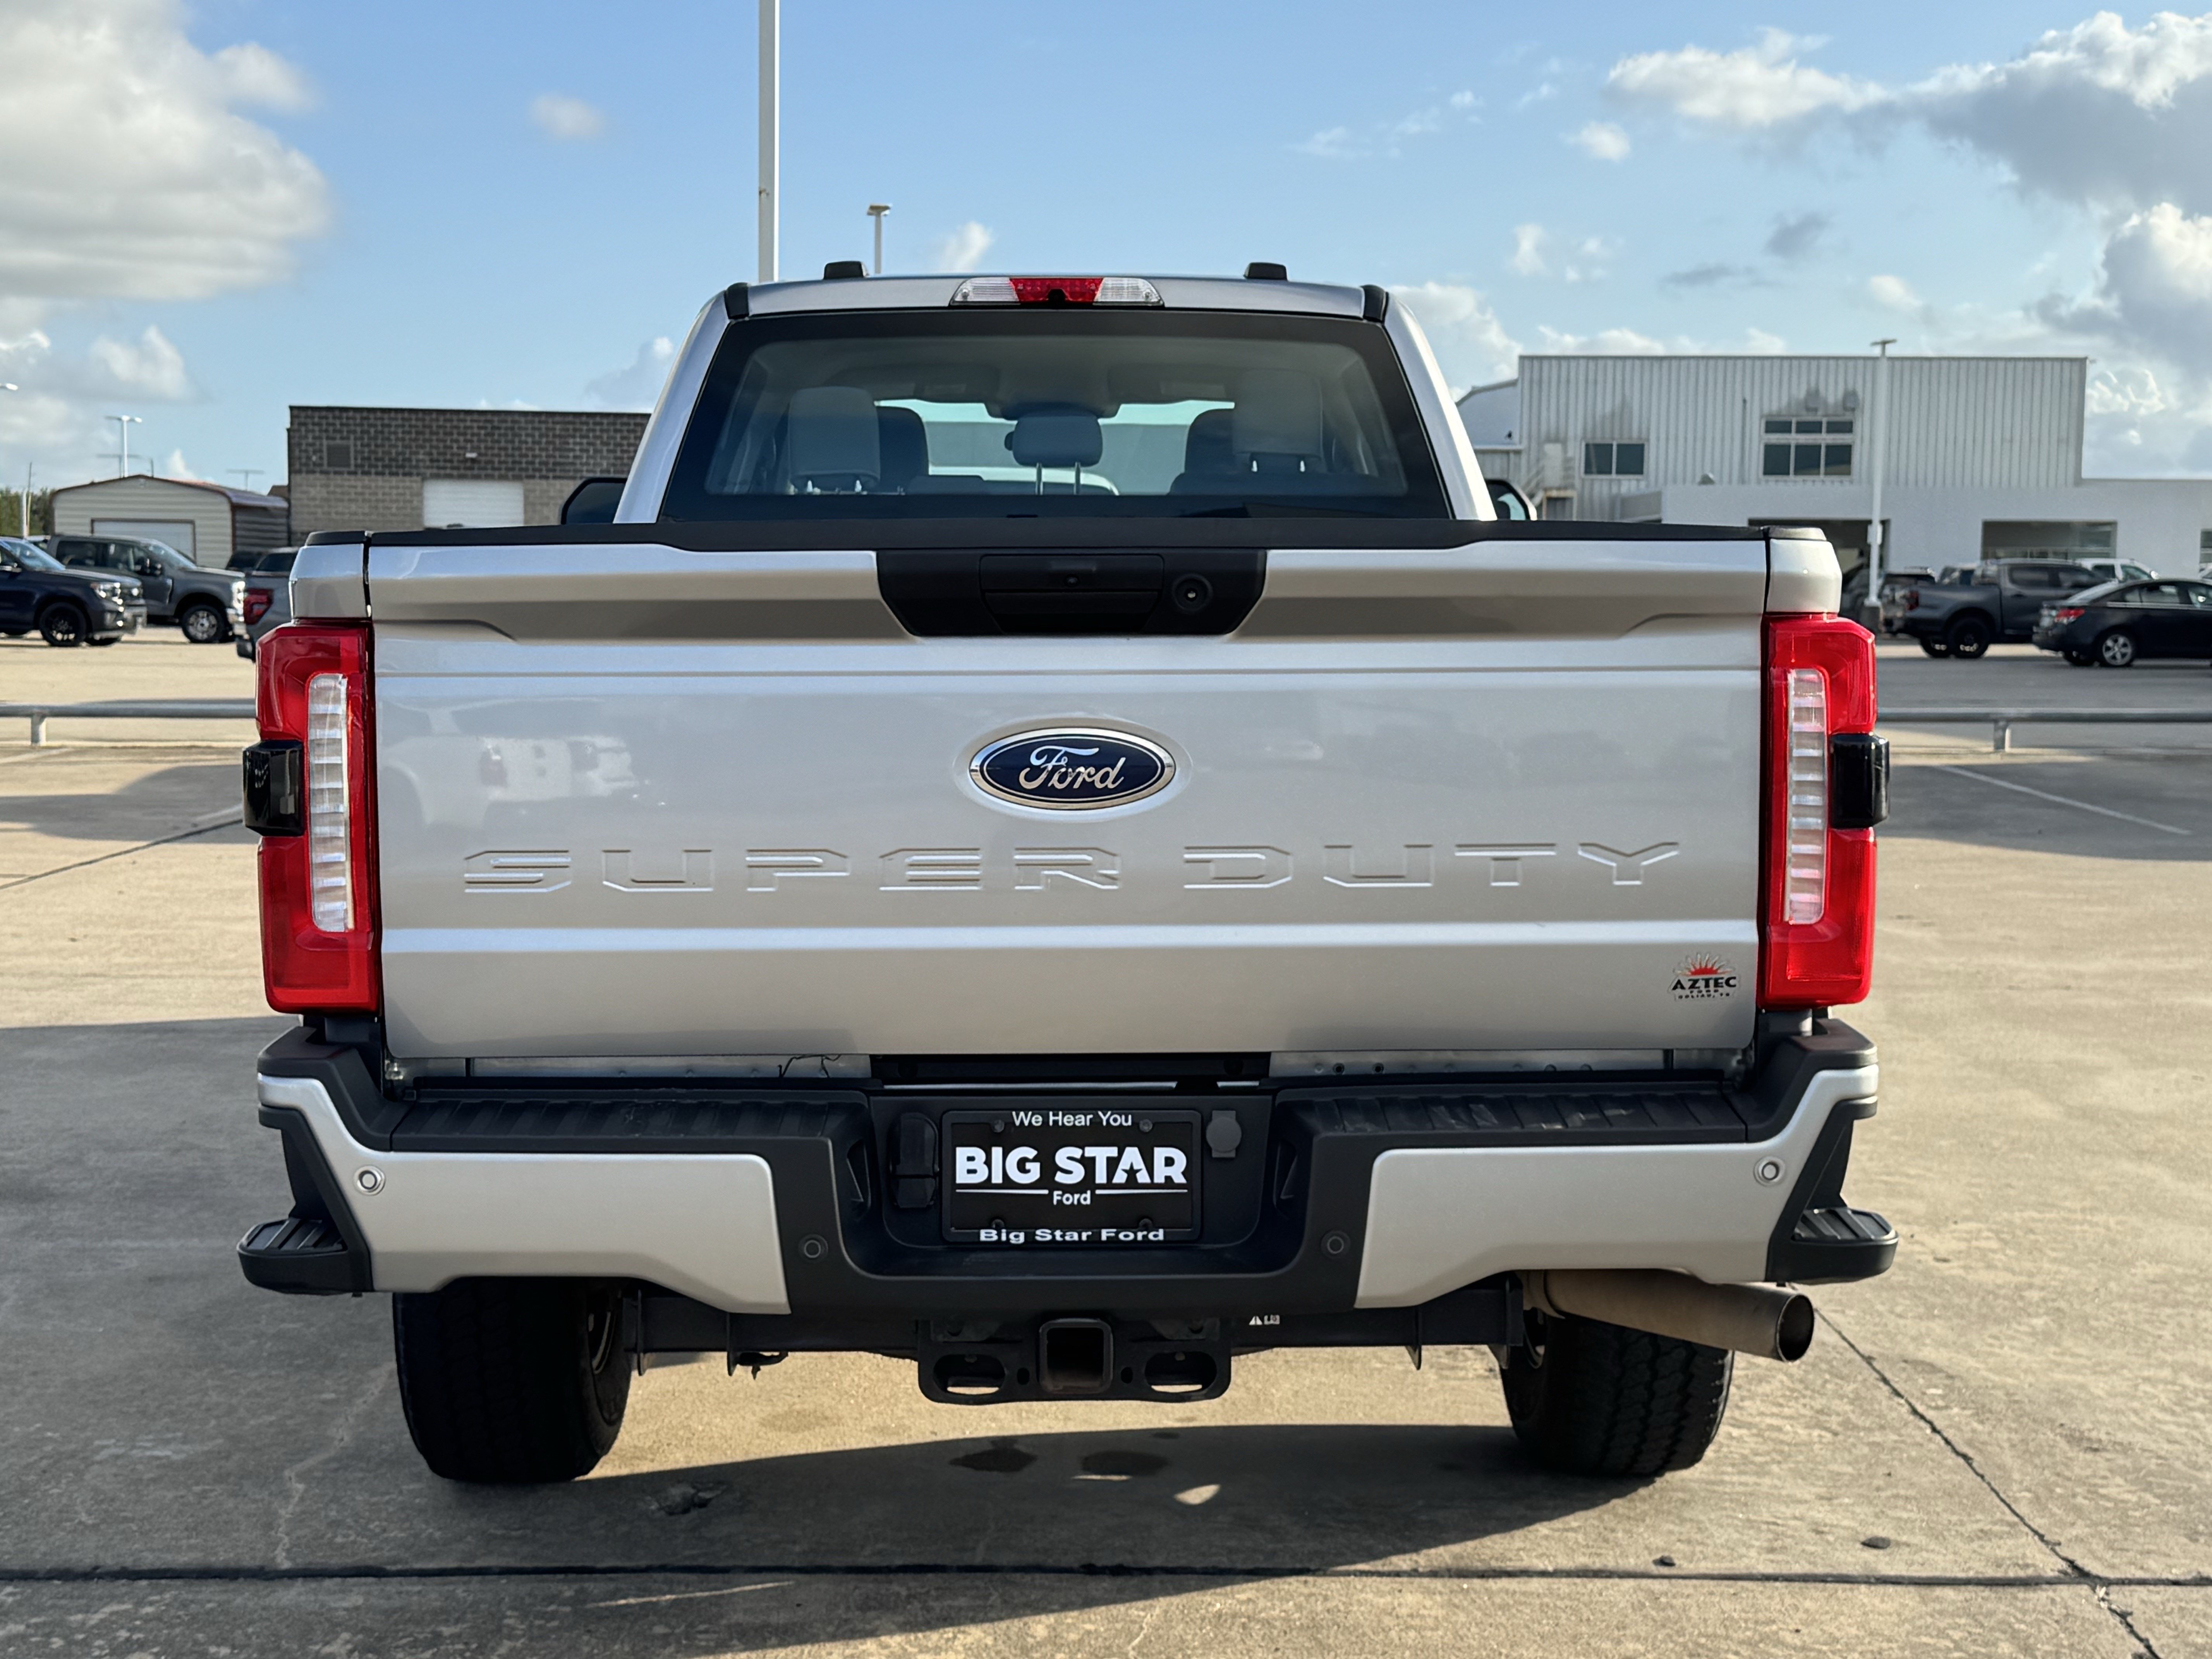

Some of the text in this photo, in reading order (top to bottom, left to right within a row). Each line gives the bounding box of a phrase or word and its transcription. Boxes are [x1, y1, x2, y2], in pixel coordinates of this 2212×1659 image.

[1019, 745, 1124, 789] Ford
[464, 842, 1680, 893] SUPER DUTY
[1672, 976, 1736, 991] AZTEC
[1012, 1111, 1132, 1126] We Hear You
[956, 1146, 1187, 1184] BIG STAR
[1053, 1190, 1091, 1205] Ford
[980, 1228, 1164, 1244] Big Star Ford
